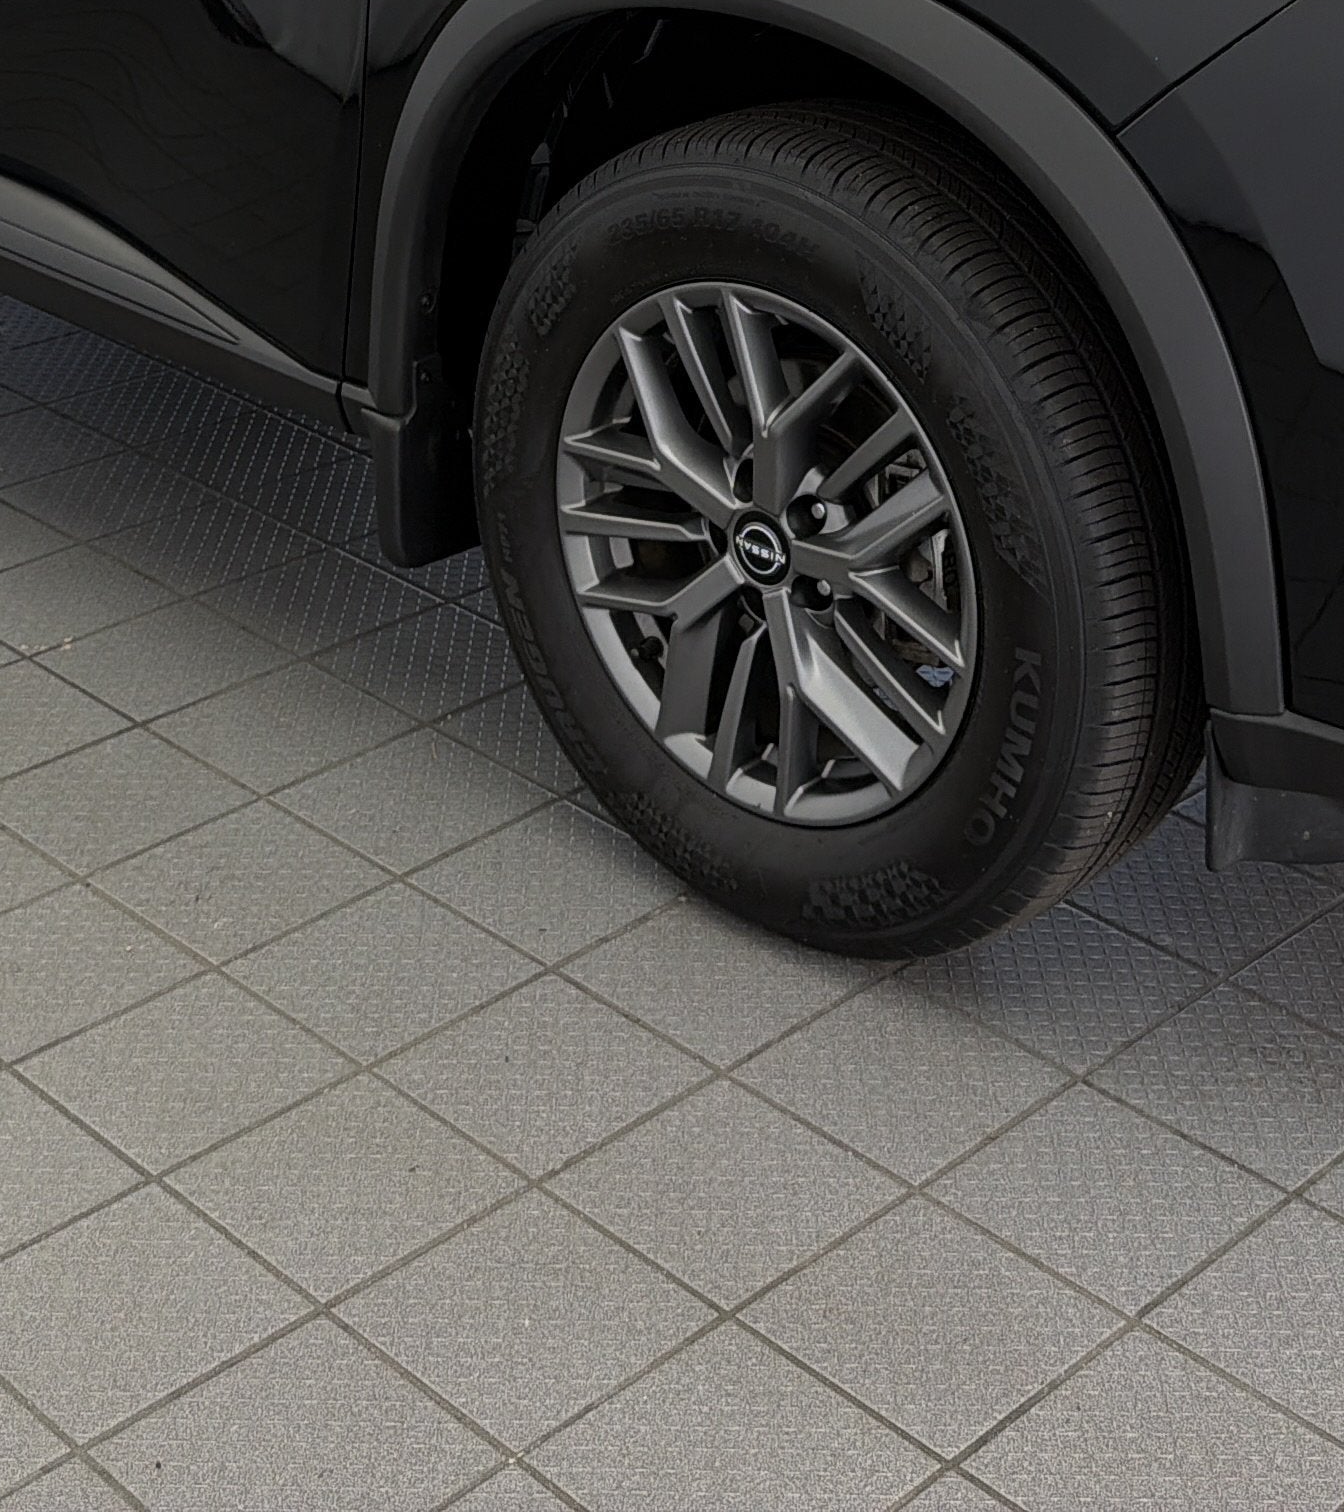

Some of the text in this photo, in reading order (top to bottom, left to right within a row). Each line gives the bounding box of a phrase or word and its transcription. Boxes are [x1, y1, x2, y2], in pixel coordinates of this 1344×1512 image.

[606, 206, 686, 246] 235/65
[692, 205, 744, 232] R17
[735, 535, 786, 564] NISSAN
[963, 645, 1043, 846] KUMHO
